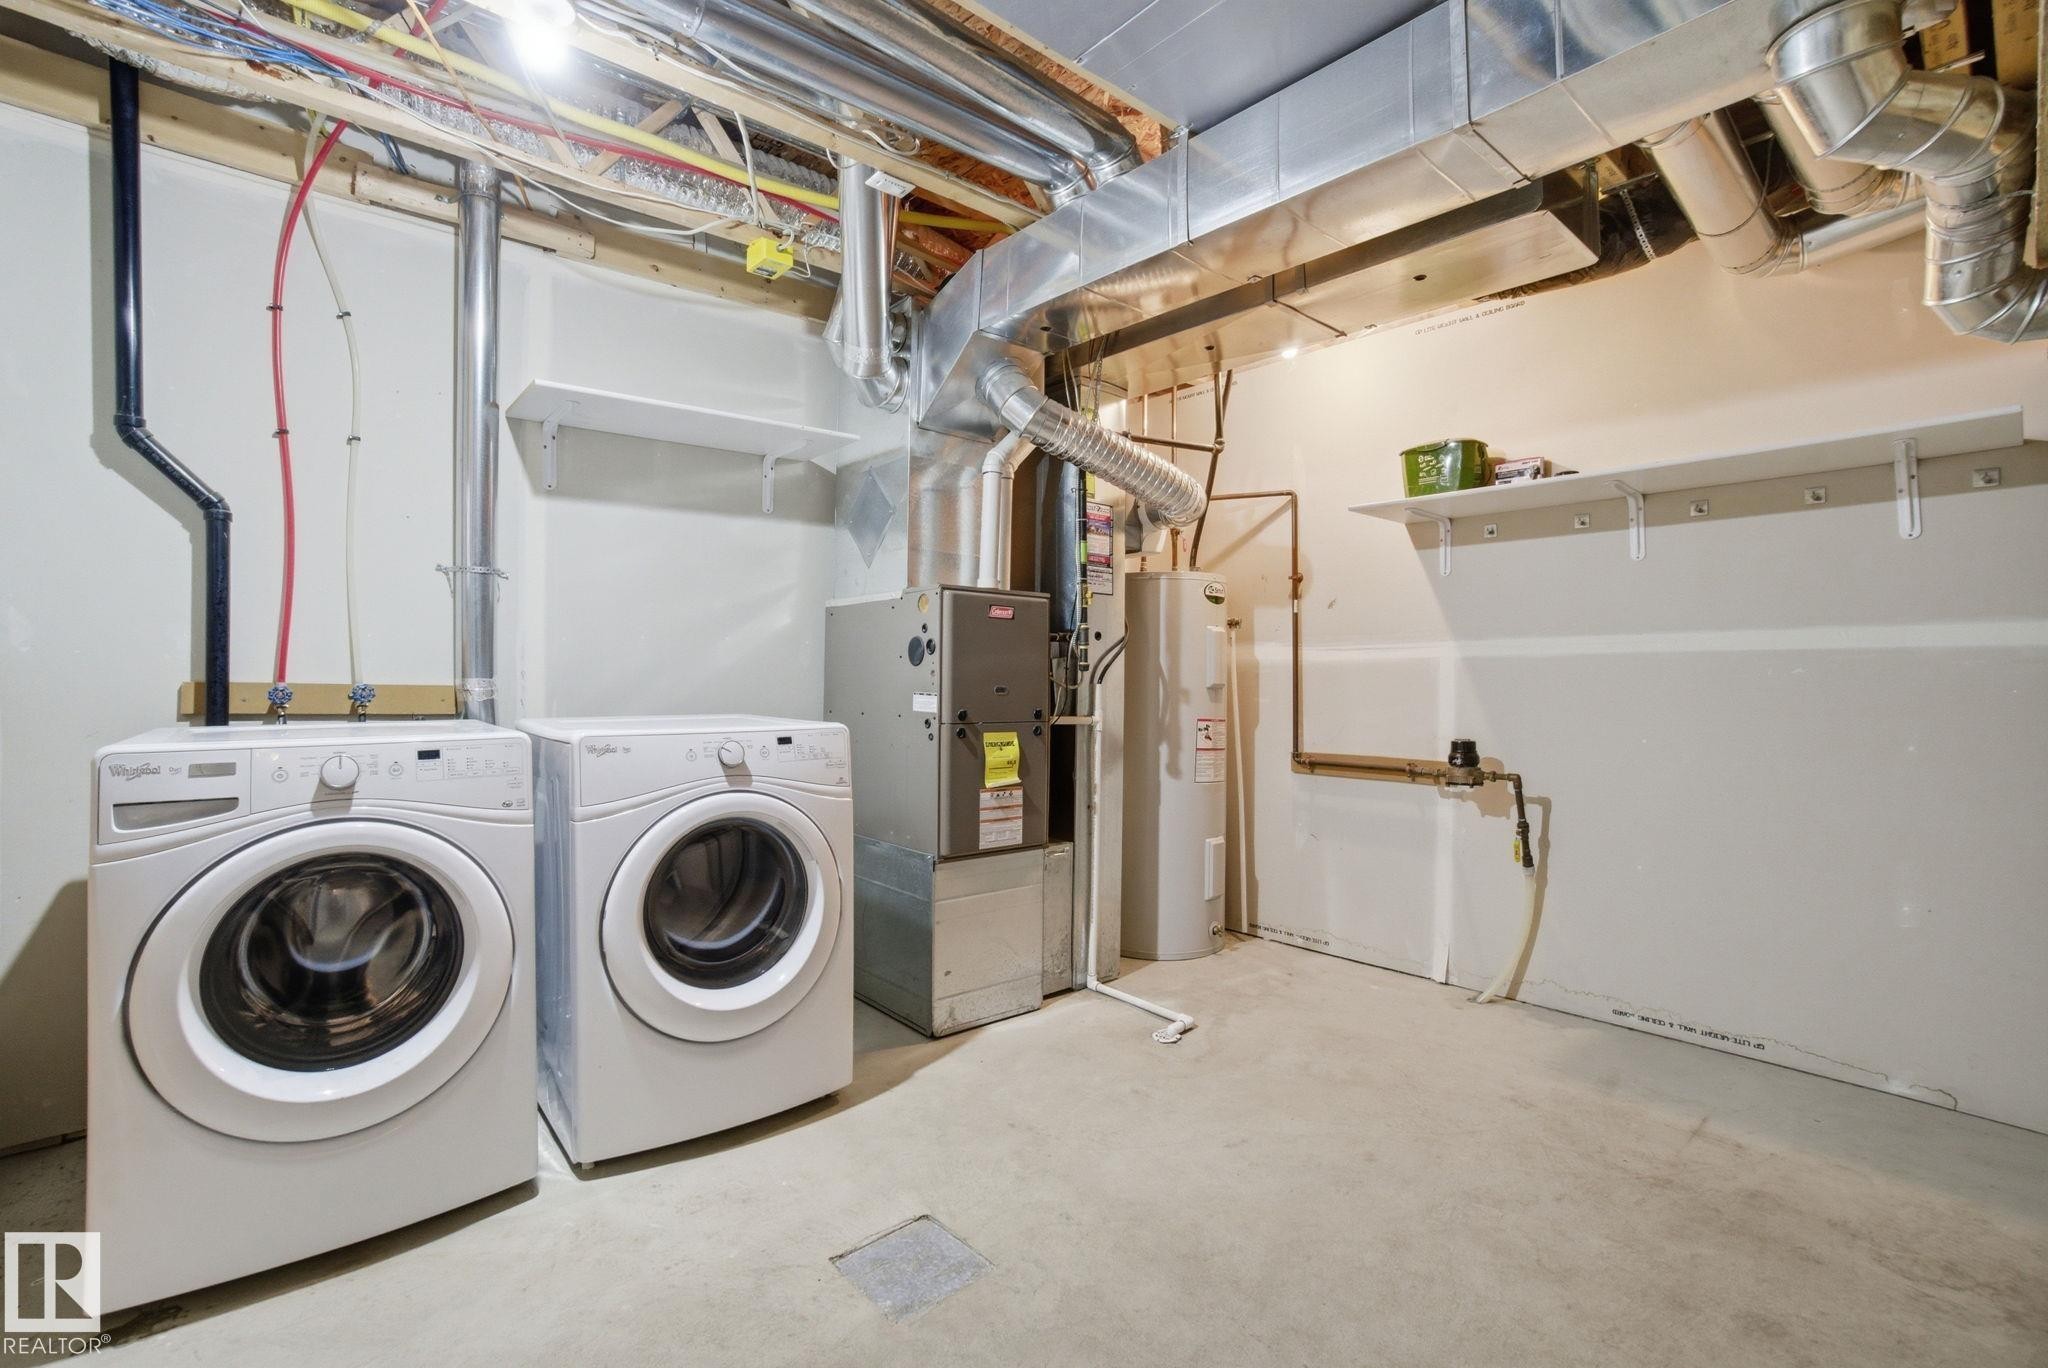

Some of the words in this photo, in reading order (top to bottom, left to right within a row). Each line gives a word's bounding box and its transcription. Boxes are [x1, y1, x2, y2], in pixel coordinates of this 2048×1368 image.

[108, 763, 161, 782] Whirlpool
[1637, 1014, 1666, 1026] CEILING
[1677, 1023, 1697, 1034] WALL
[1753, 1043, 1765, 1051] GP
